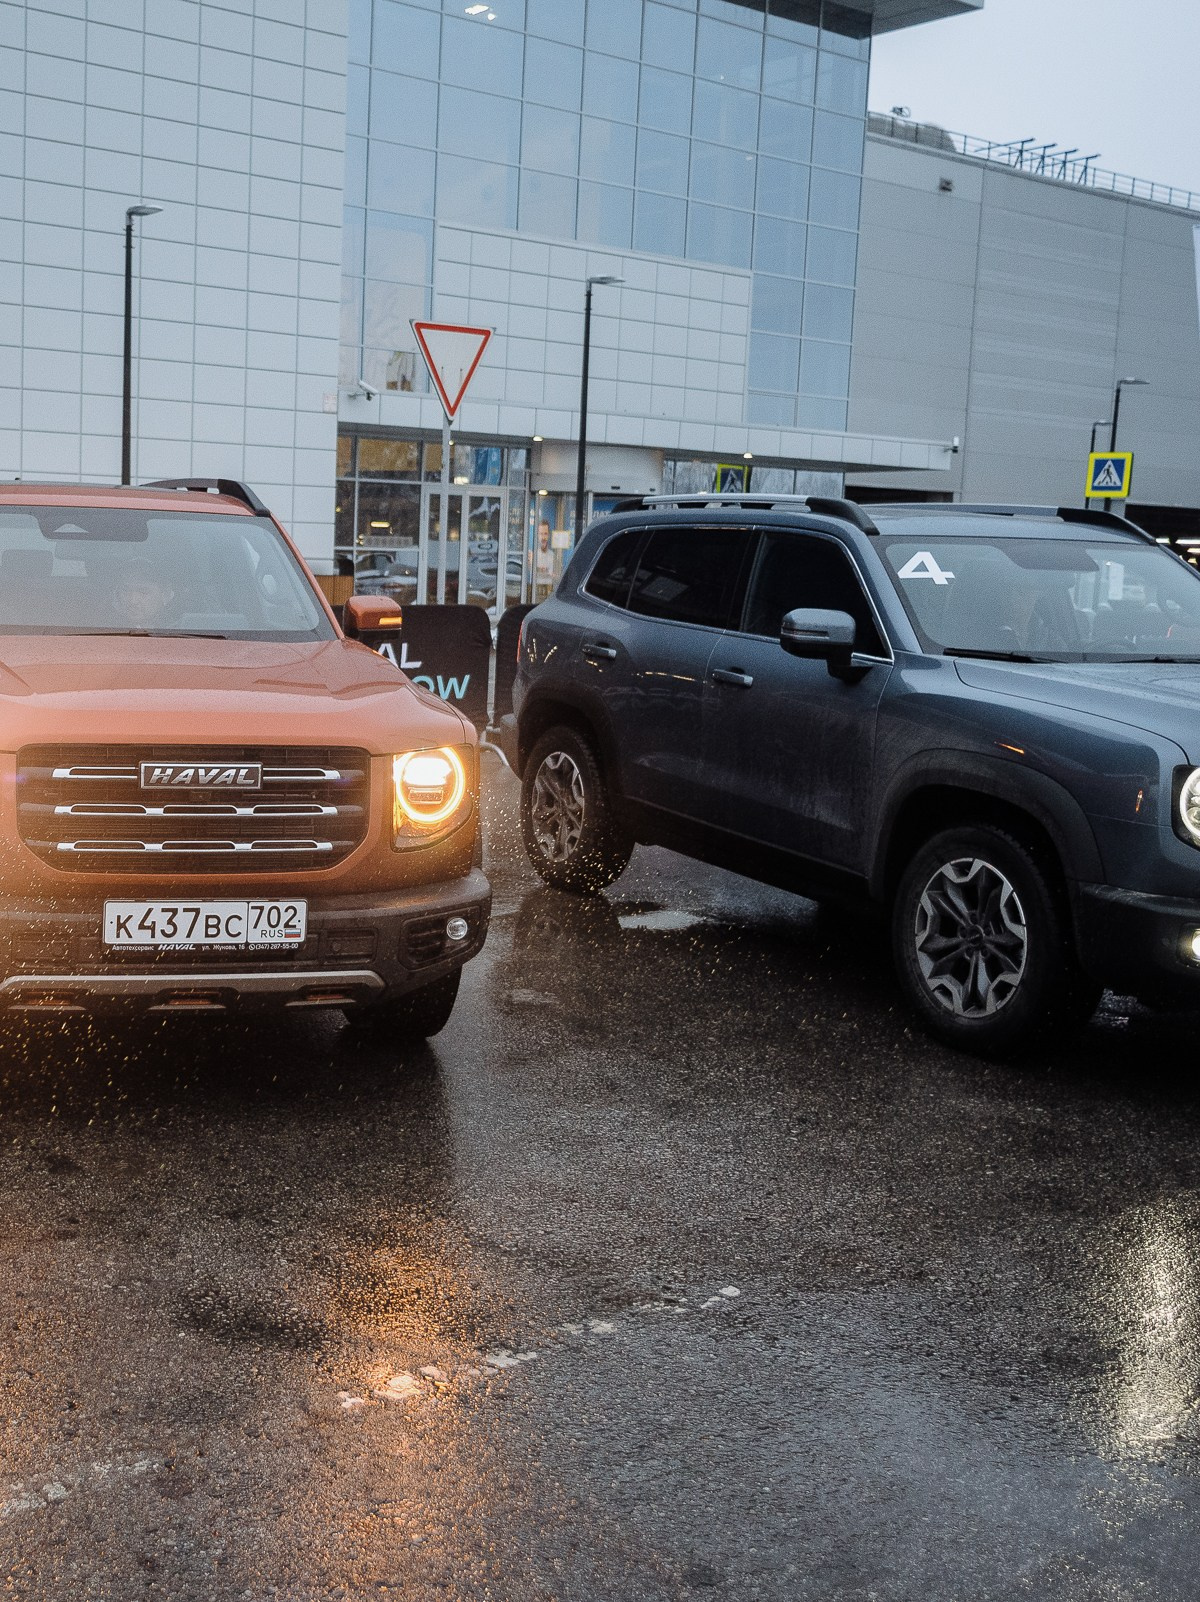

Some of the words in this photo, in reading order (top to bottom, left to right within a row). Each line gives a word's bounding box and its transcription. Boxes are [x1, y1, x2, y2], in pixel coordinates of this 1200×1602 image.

[897, 551, 956, 585] 4
[148, 768, 255, 784] HAVAL
[115, 907, 243, 939] К437ВС
[250, 905, 298, 929] 702
[260, 929, 284, 938] RUS
[112, 944, 154, 952] Автотехсервис
[157, 943, 196, 951] HAVAL
[255, 943, 270, 951] (347)
